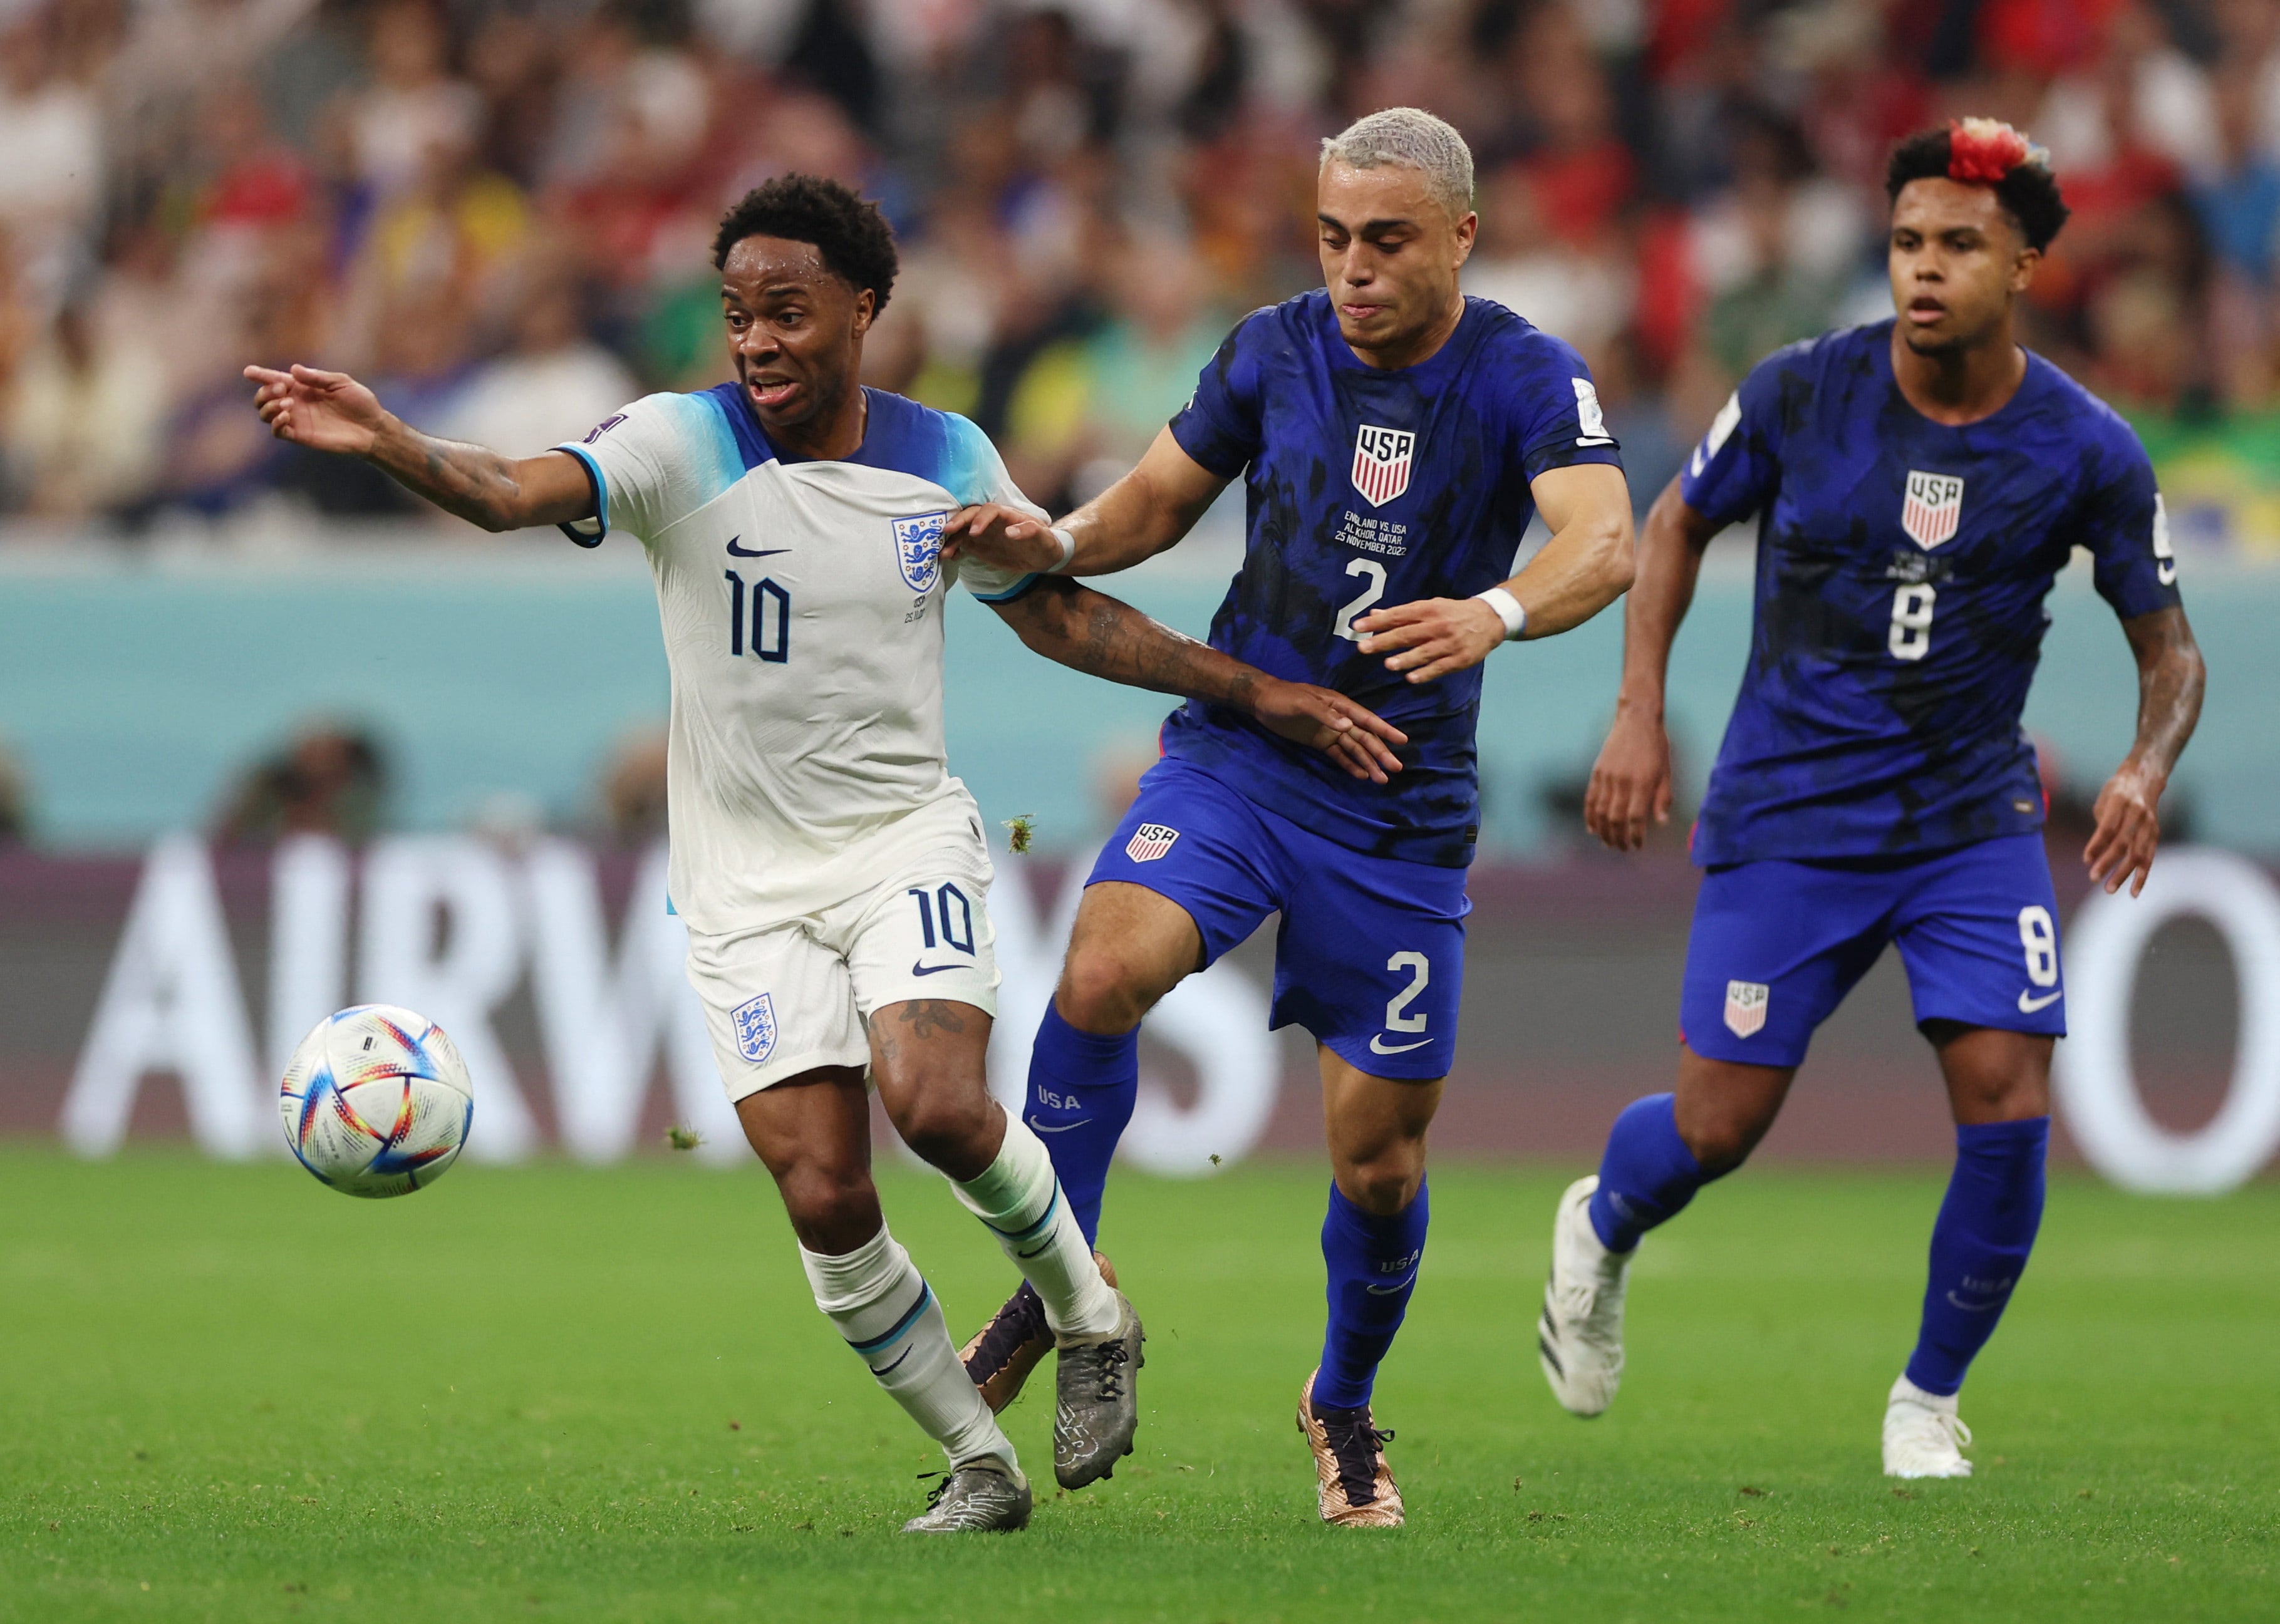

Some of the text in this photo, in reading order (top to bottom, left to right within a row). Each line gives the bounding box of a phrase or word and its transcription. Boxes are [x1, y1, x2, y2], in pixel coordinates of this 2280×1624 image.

[1360, 429, 1411, 462] USA
[1912, 477, 1959, 506] USA
[1344, 510, 1407, 535] ENGLAND VS. USA
[1344, 522, 1403, 545] AL KHOR, QATAR
[1335, 530, 1407, 556] 25 NOVEMBER 2022
[1332, 557, 1388, 643] 2
[724, 569, 790, 665] 10
[1888, 583, 1937, 661] 8
[1139, 825, 1176, 842] USA
[908, 881, 976, 958] 10
[2018, 906, 2059, 987] 8
[1385, 951, 1430, 1033] 2
[1038, 1084, 1082, 1110] USA
[1380, 1248, 1419, 1273] USA
